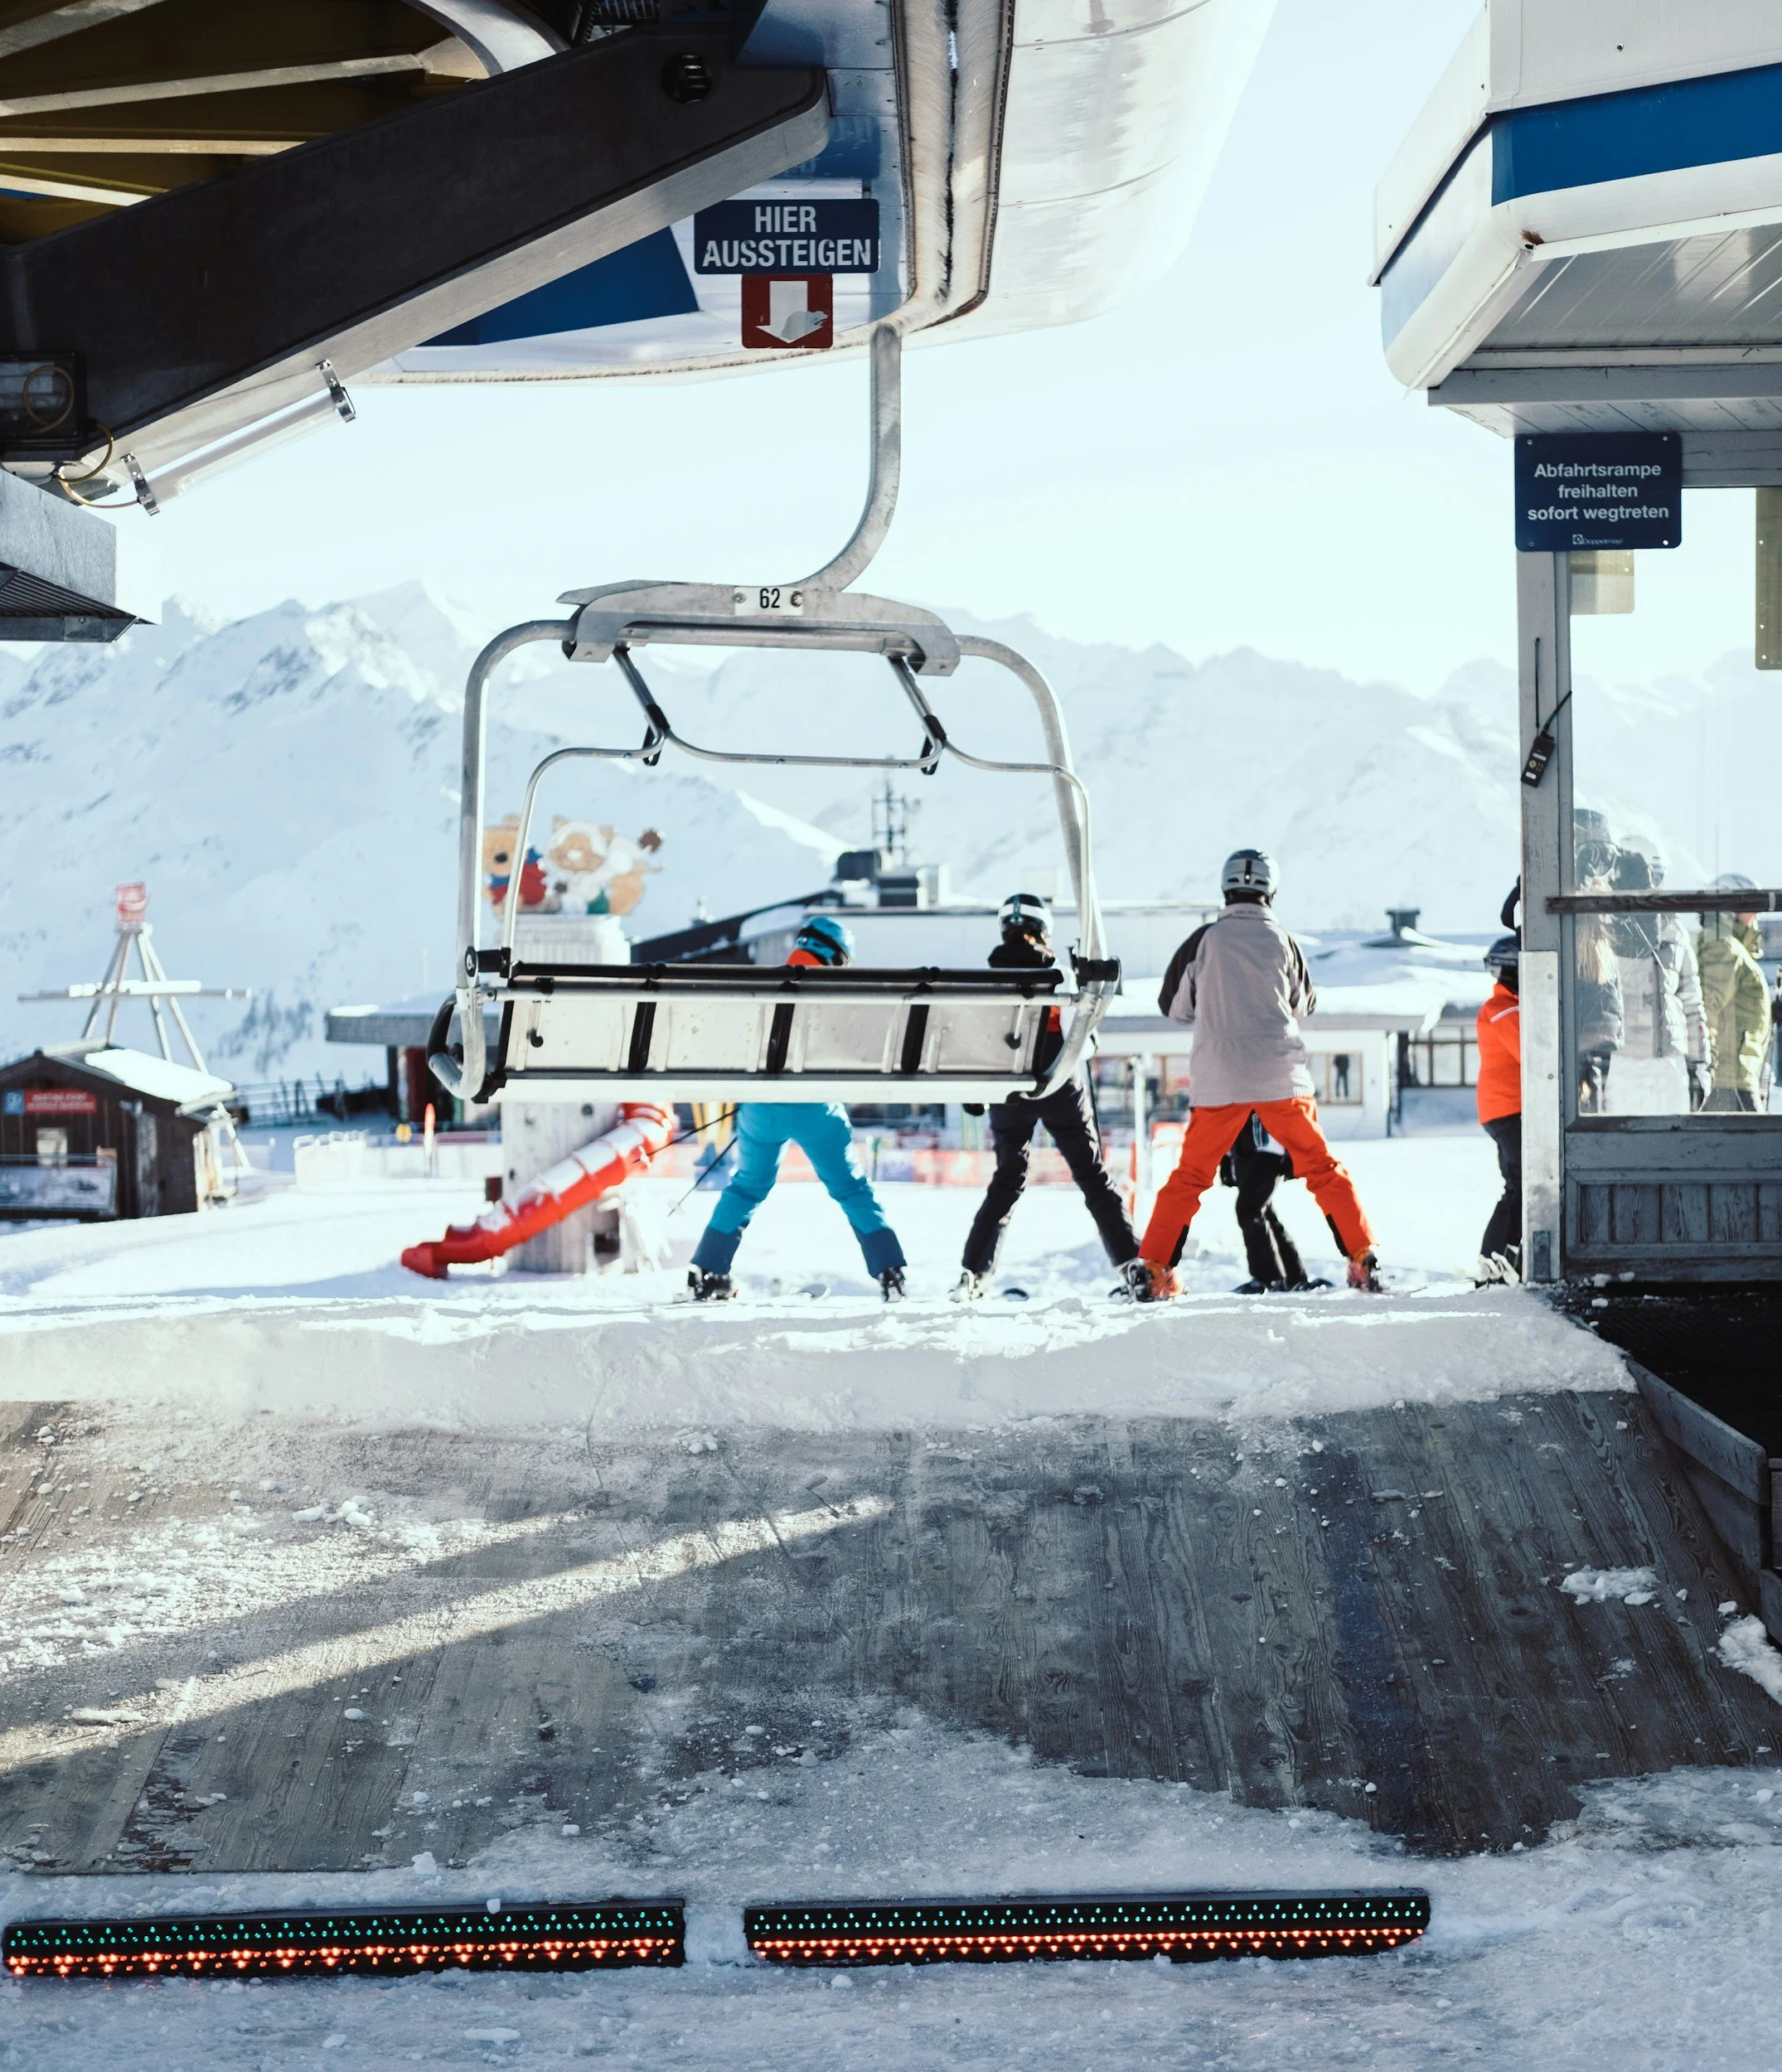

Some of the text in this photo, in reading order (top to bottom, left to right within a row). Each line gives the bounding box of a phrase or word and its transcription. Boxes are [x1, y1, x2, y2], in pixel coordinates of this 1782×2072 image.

[754, 206, 816, 233] HIER
[702, 238, 871, 268] AUSSTEIGEN
[1533, 462, 1662, 479] Abfahrtsrampe
[1557, 483, 1639, 499] freihalten
[1527, 504, 1669, 522] sofort wegtreten
[759, 588, 781, 609] 62
